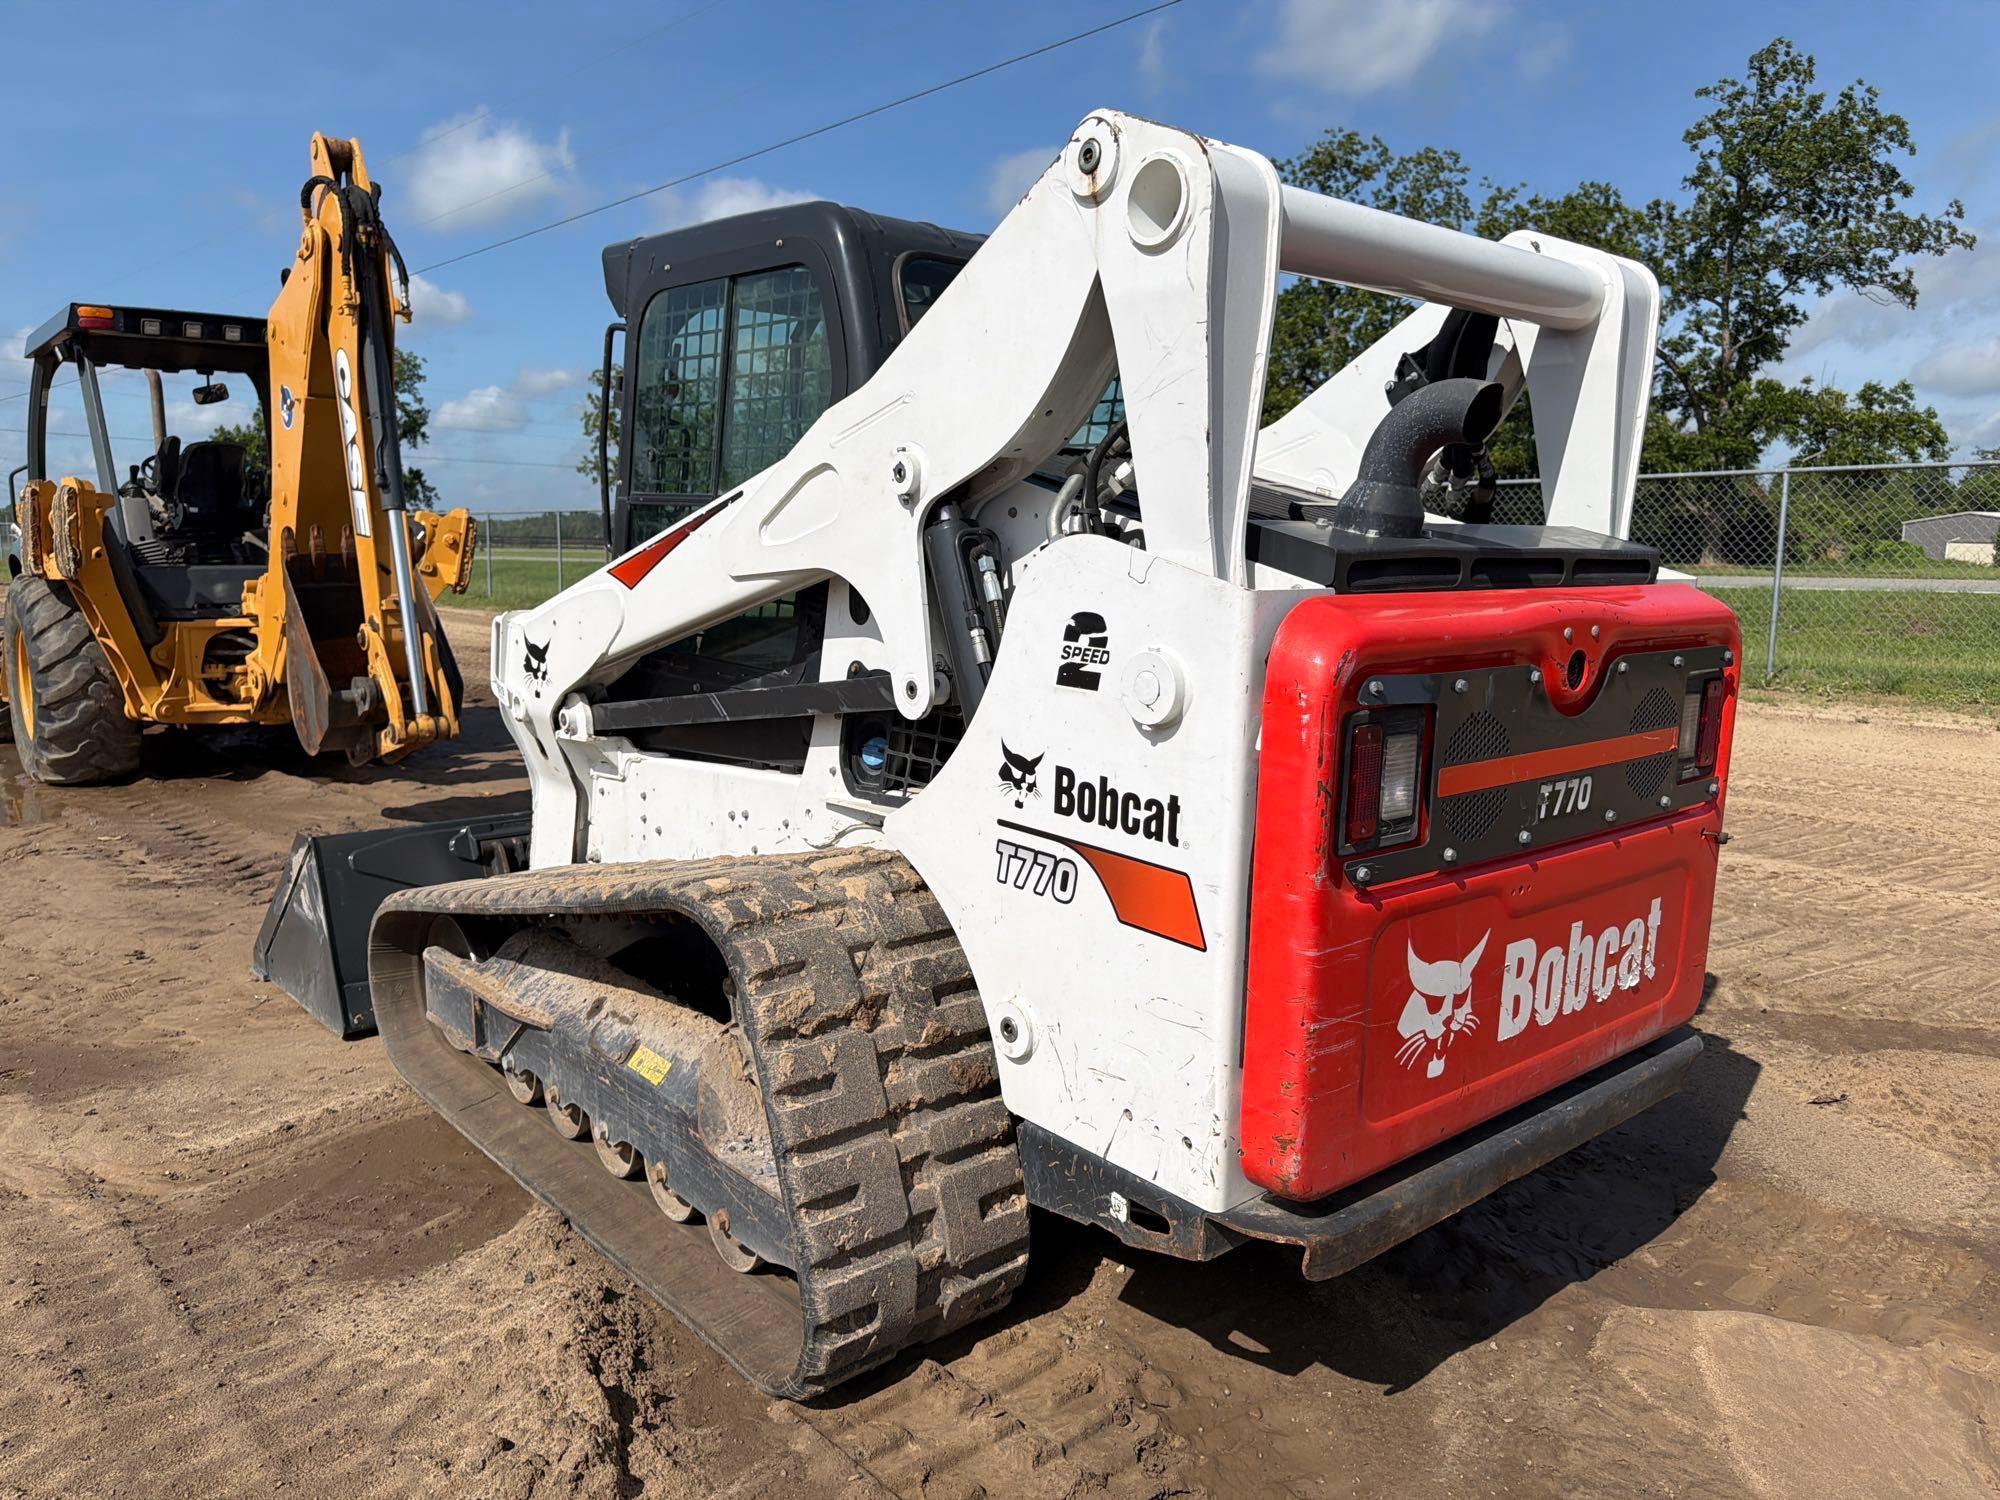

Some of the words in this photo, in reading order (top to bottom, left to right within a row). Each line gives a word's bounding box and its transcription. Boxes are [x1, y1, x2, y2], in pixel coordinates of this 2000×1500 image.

[335, 347, 371, 538] CASE
[1056, 611, 1109, 692] 2
[1060, 645, 1110, 665] SPEED
[1054, 765, 1181, 848] Bobcat
[1540, 775, 1593, 819] T770
[996, 838, 1079, 905] T770
[1497, 896, 1662, 1042] Bobcat
